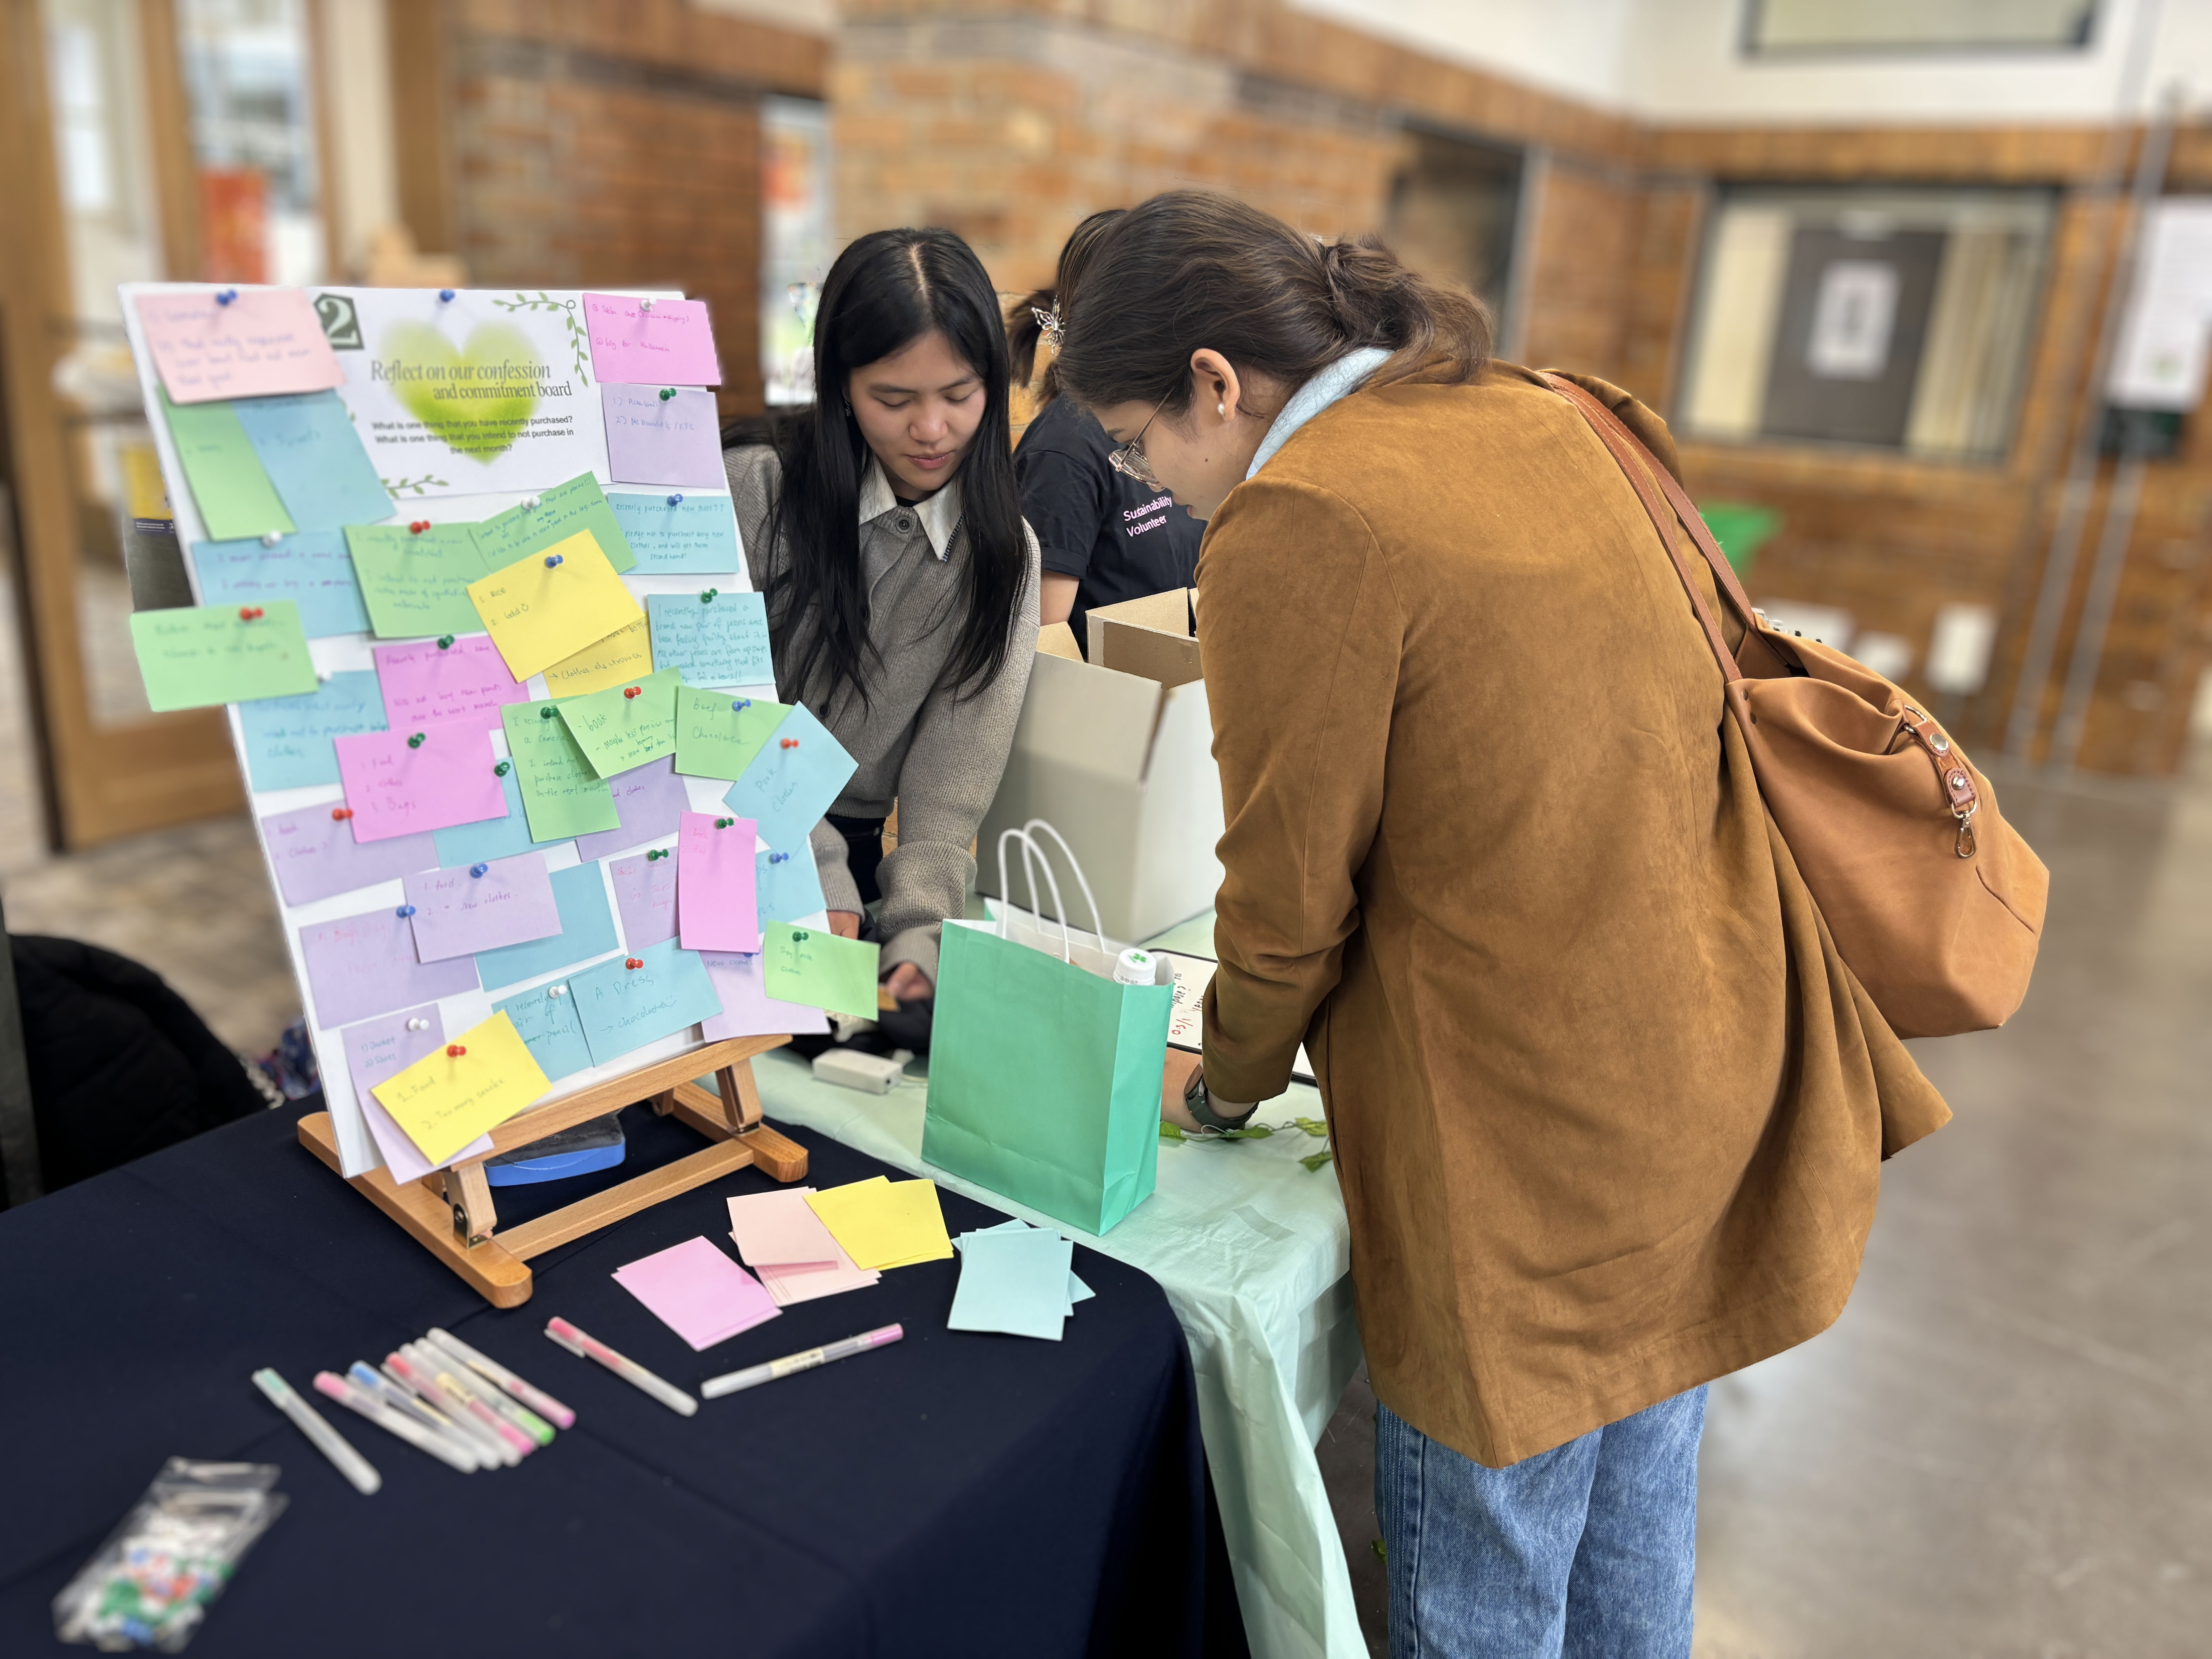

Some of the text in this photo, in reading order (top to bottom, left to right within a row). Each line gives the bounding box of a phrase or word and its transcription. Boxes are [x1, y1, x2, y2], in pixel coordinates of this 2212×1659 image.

[606, 338, 617, 350] Wig
[371, 359, 551, 385] Reflect on our confession
[433, 381, 572, 399] and commitment board
[371, 421, 394, 430] What
[397, 421, 404, 429] is
[423, 421, 445, 430] thing
[464, 421, 478, 429] you
[499, 418, 529, 426] recently
[530, 416, 573, 426] purchased?
[616, 416, 626, 424] 2)
[374, 435, 398, 443] What
[400, 434, 407, 443] is
[426, 434, 448, 443] thing
[466, 434, 481, 442] you
[531, 430, 565, 439] purchase
[483, 444, 512, 453] month?
[546, 495, 556, 503] that
[1126, 515, 1167, 537] Volunteer
[697, 531, 709, 540] any
[702, 603, 737, 618] purchased
[583, 714, 608, 731] book
[595, 974, 655, 1001] A Dress
[545, 1003, 555, 1025] of
